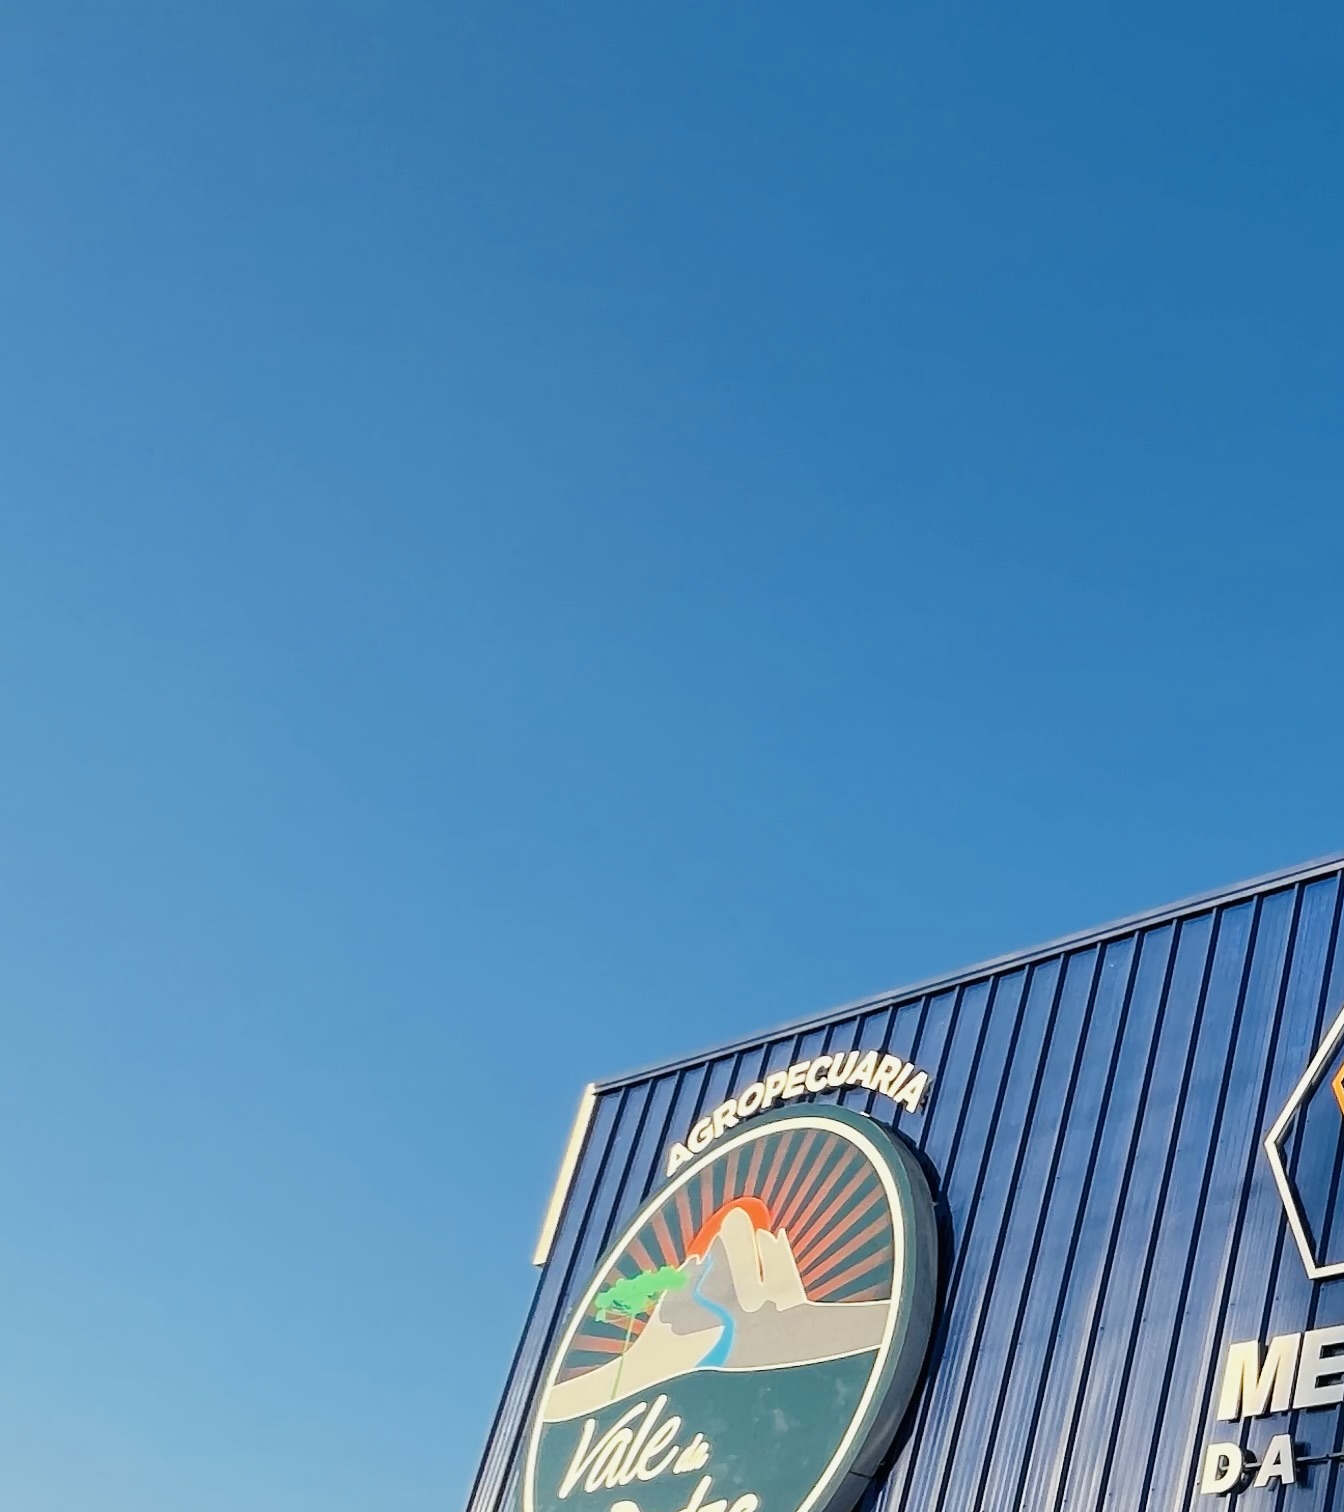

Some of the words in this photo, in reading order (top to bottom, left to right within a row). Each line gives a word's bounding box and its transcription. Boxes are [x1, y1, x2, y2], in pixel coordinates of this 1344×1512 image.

[666, 1050, 928, 1177] AGROPECUARIA
[557, 1394, 683, 1499] Vale
[1200, 1433, 1295, 1495] DA
